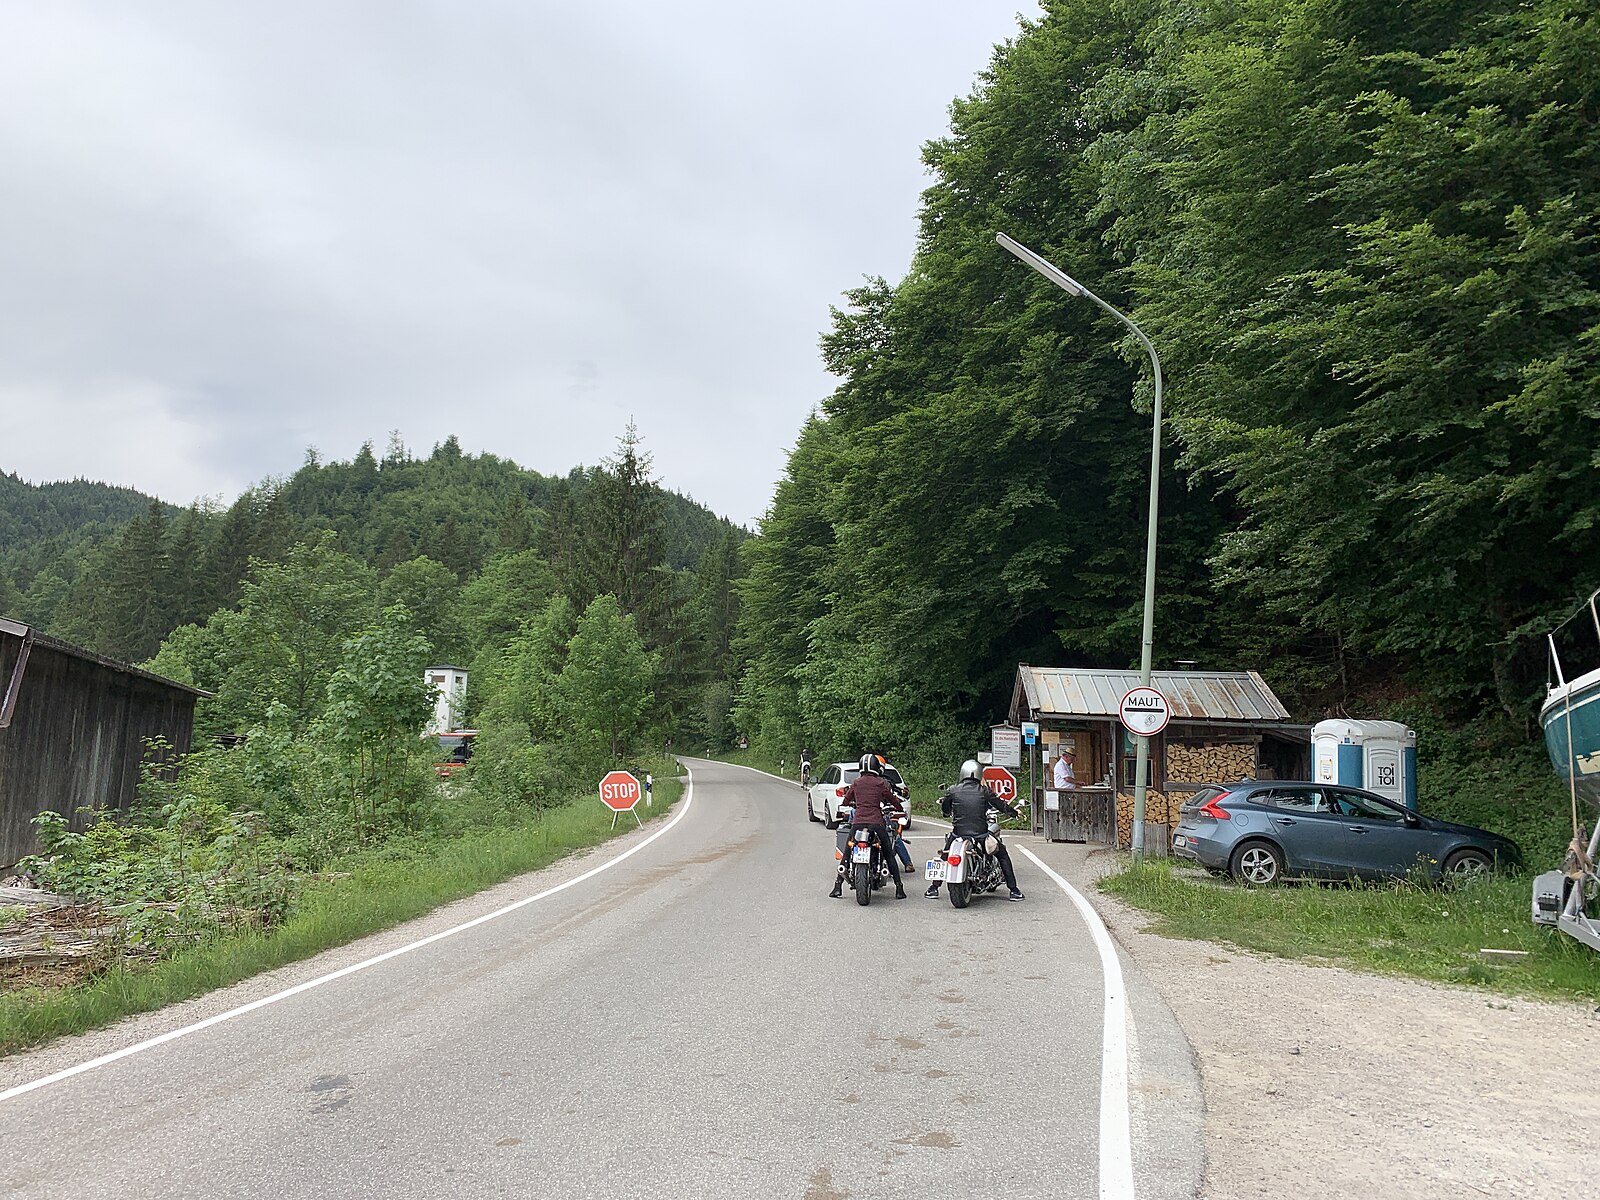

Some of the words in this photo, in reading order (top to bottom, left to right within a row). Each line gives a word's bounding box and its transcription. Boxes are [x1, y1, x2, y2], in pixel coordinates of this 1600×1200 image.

[1128, 697, 1160, 707] MAUT
[986, 779, 1012, 795] TOP
[1378, 776, 1395, 786] TOI
[603, 783, 636, 799] STOP
